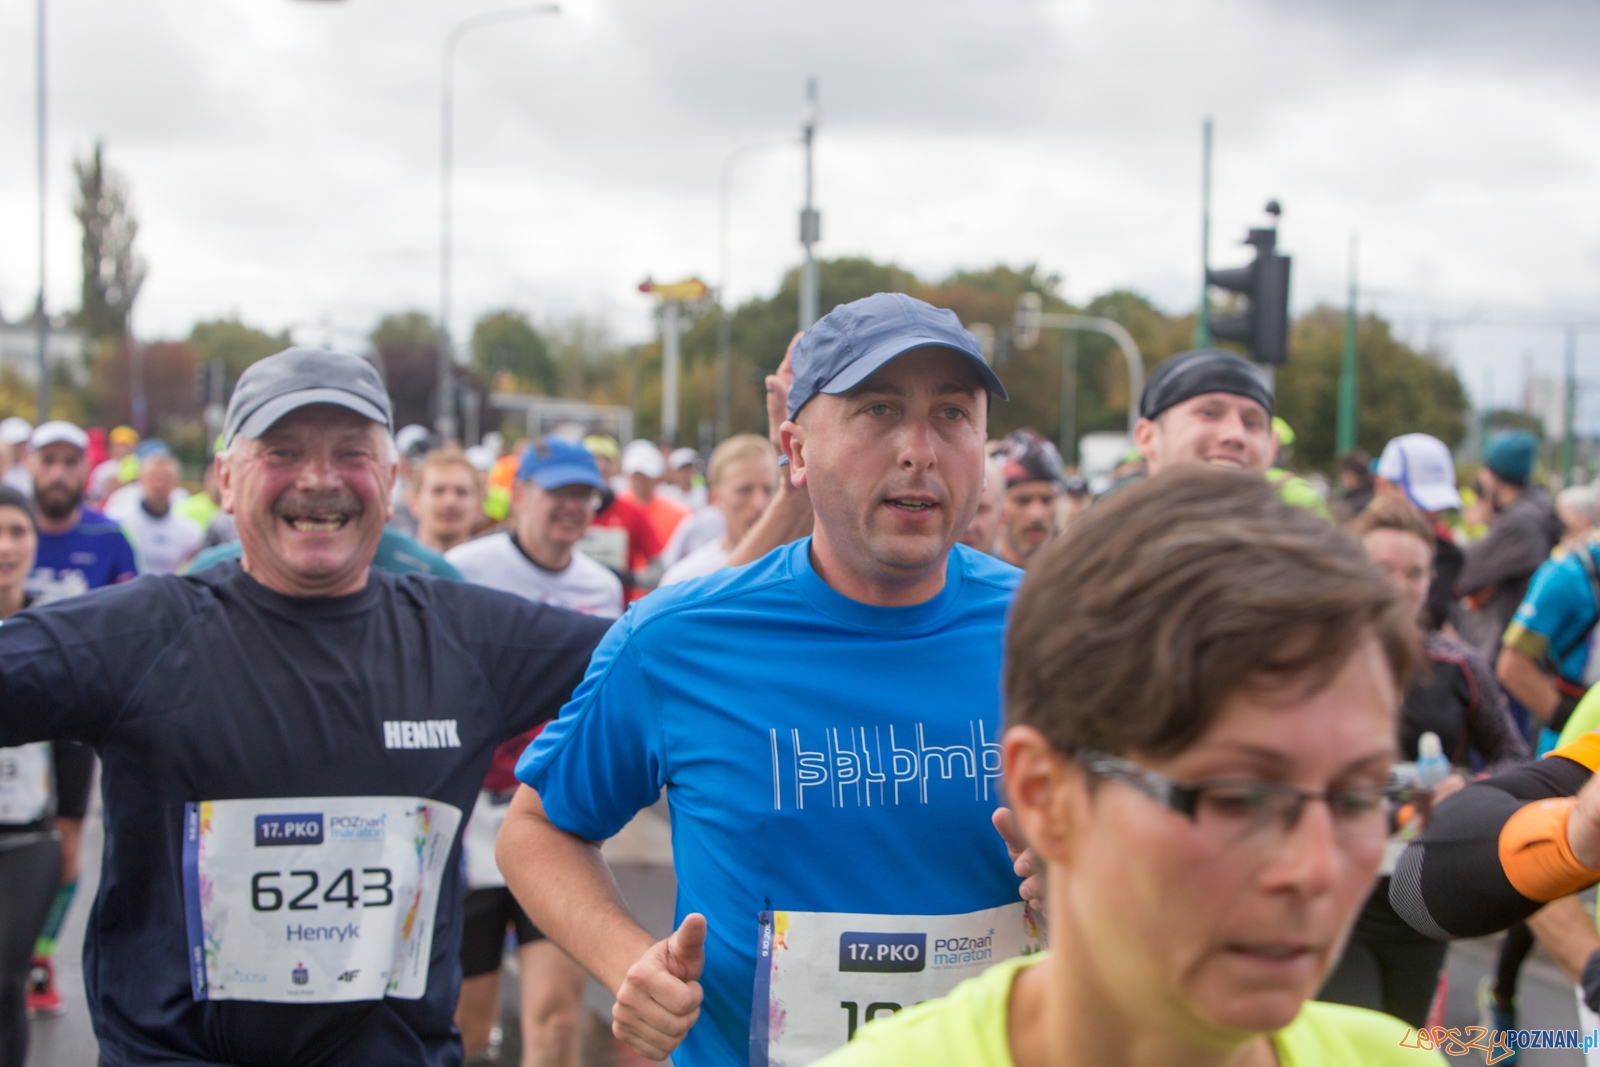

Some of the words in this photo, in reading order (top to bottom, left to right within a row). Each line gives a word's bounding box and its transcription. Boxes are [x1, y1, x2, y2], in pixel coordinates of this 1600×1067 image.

[383, 719, 461, 750] HENRYK
[260, 822, 284, 838] 17.
[285, 821, 319, 838] PKO
[251, 867, 393, 912] 6243
[286, 923, 361, 943] Henryk
[848, 943, 873, 962] 17.
[877, 944, 919, 961] PKO
[934, 948, 992, 965] maraton
